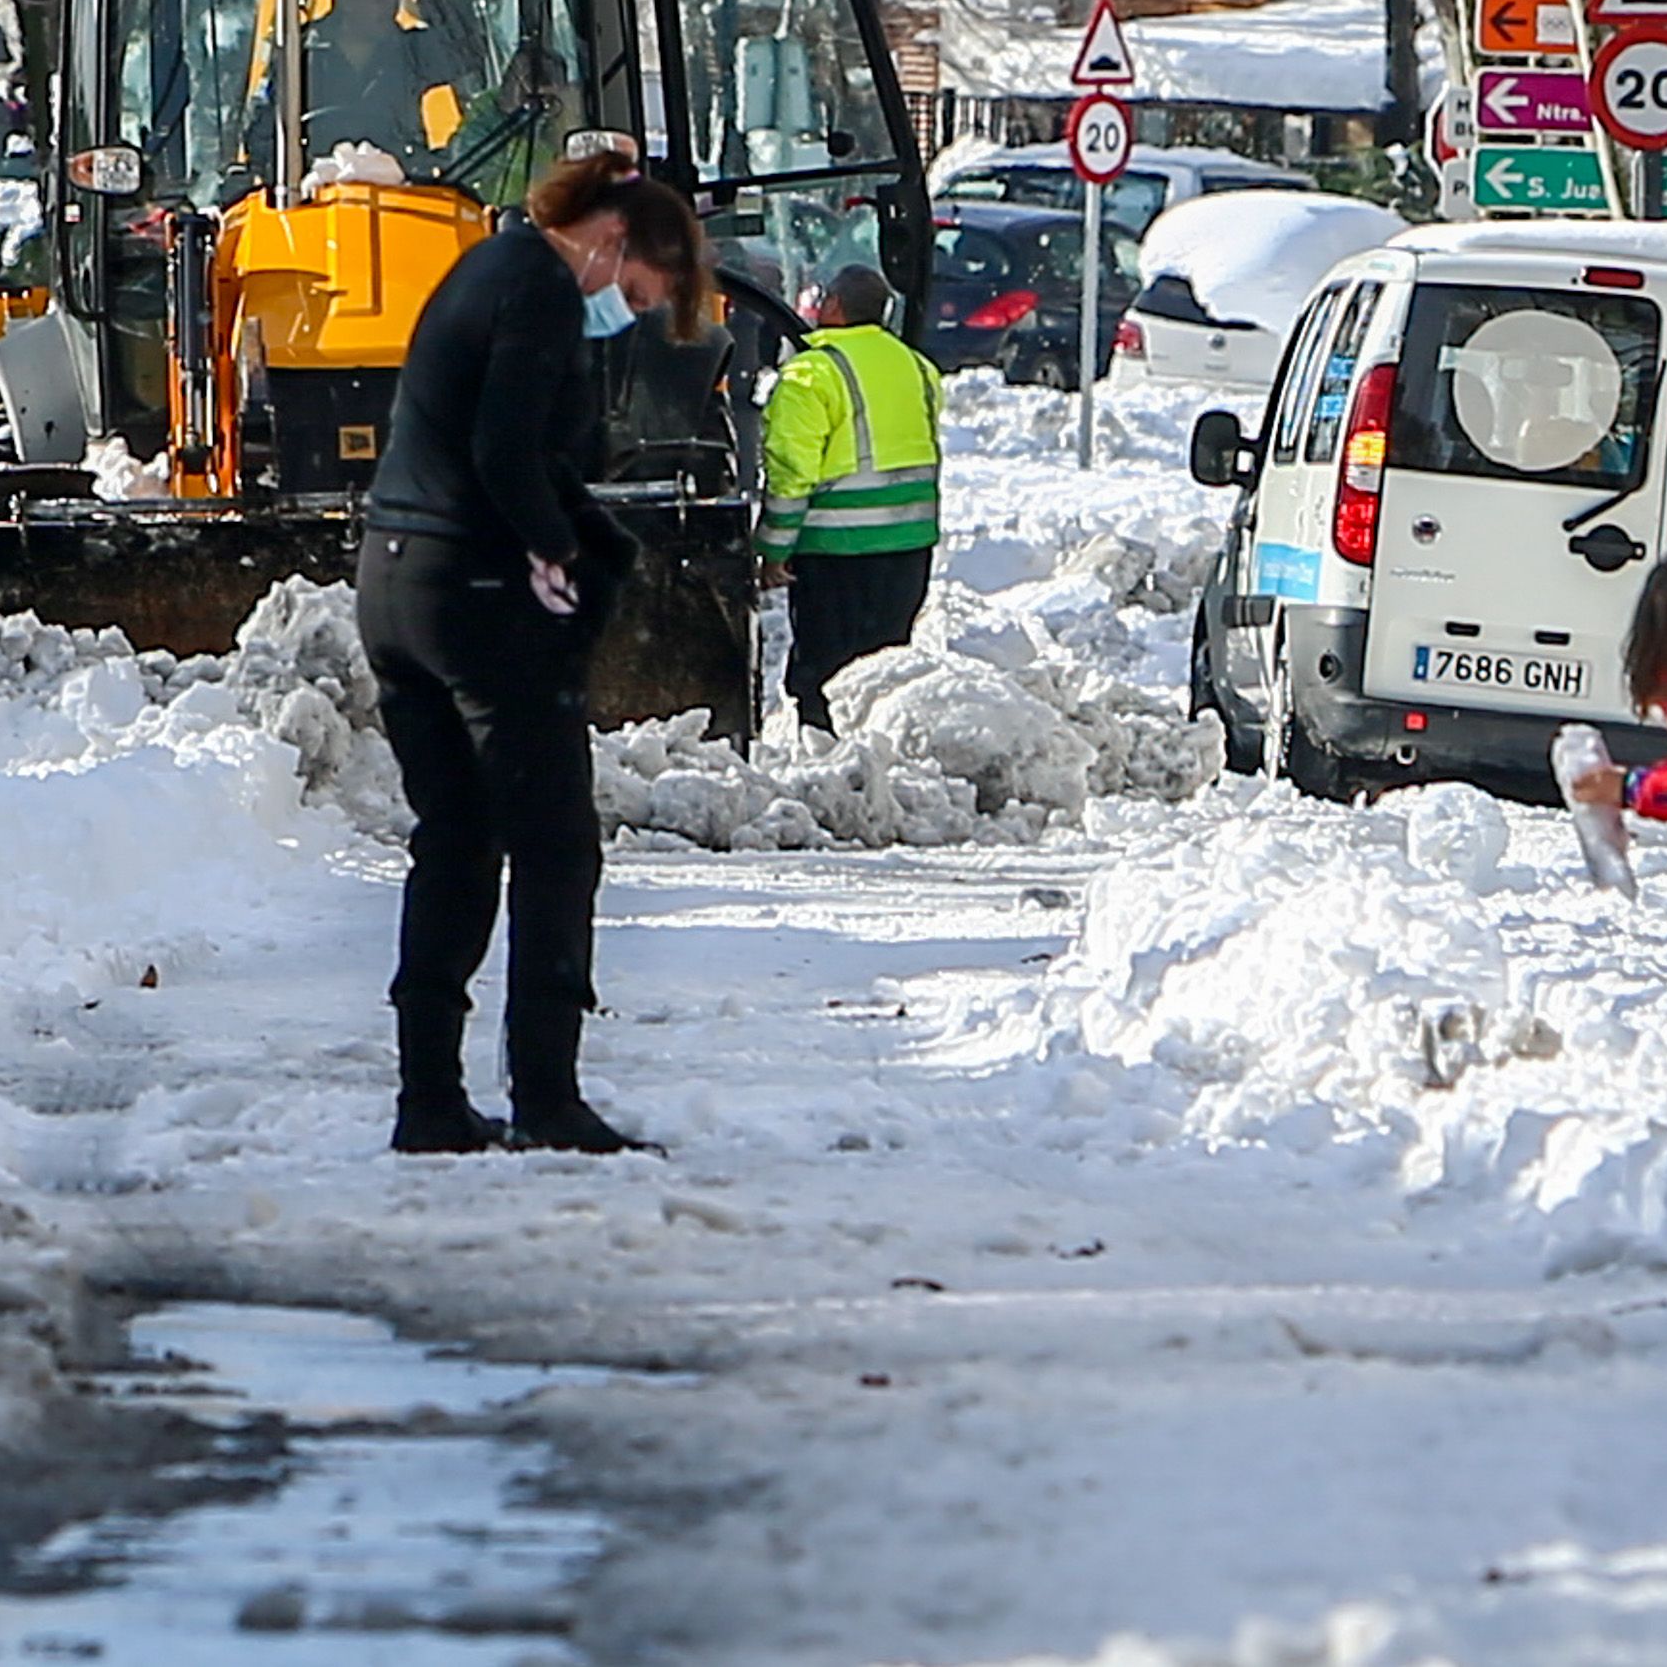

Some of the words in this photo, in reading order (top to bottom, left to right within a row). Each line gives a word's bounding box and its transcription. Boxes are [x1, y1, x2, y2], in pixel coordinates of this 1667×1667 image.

[1536, 103, 1588, 122] Ntra.
[1086, 121, 1121, 153] 20
[1560, 177, 1605, 200] Jua
[1436, 651, 1513, 685] 7686
[1524, 660, 1583, 695] GNH
